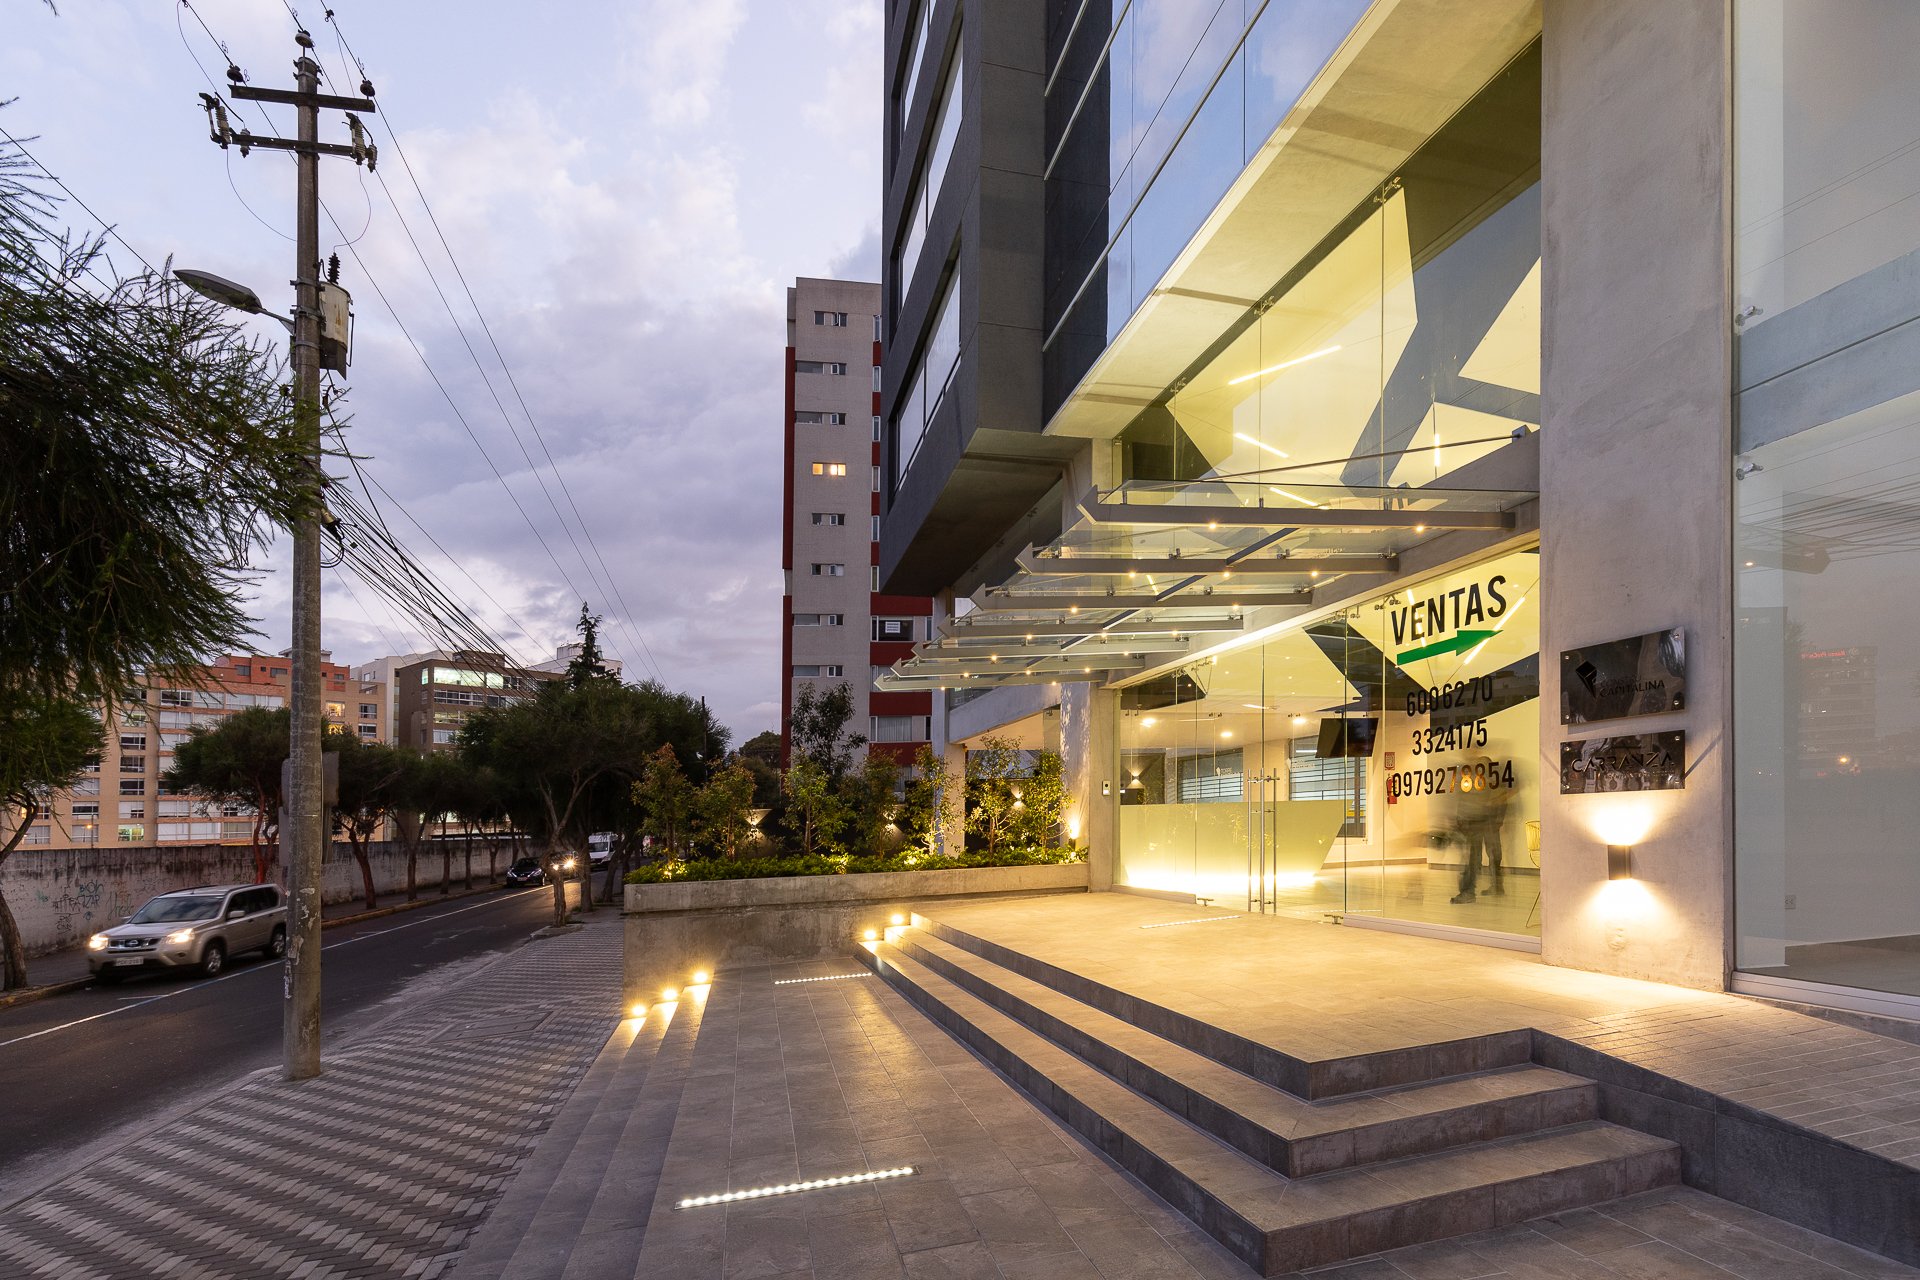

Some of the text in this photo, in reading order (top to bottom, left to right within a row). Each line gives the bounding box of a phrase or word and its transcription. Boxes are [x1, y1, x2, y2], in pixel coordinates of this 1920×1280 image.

[1391, 575, 1507, 645] VENTAS
[1412, 719, 1488, 756] 3324175
[1392, 760, 1515, 797] 0979278854
[1571, 752, 1675, 772] CARRANZA
